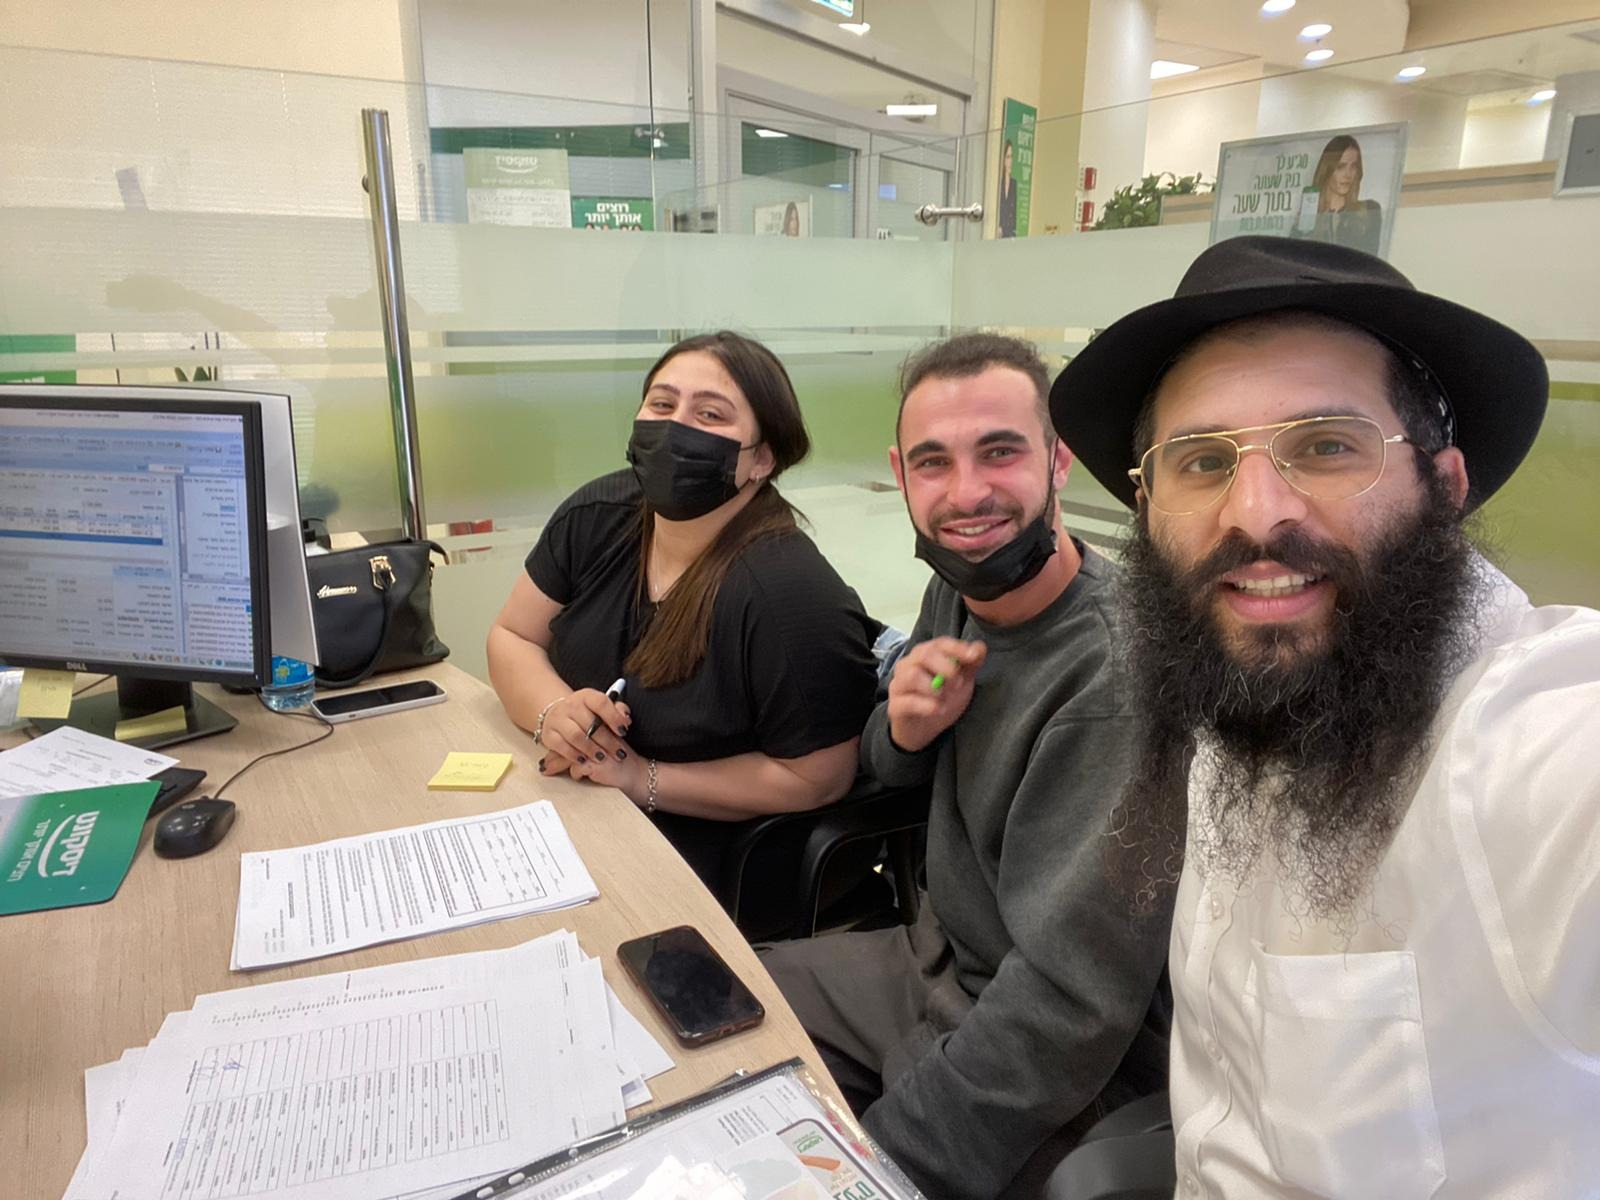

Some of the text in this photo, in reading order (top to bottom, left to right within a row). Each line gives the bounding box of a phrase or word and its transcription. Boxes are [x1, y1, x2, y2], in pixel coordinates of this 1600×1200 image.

[1275, 153, 1309, 174] מגיע לך
[1254, 172, 1301, 190] בנק שעונה
[596, 202, 629, 212] רוצים
[1232, 190, 1292, 215] בתוך שעה
[585, 213, 641, 226] אותך יותר
[51, 810, 100, 876] דיסקונט
